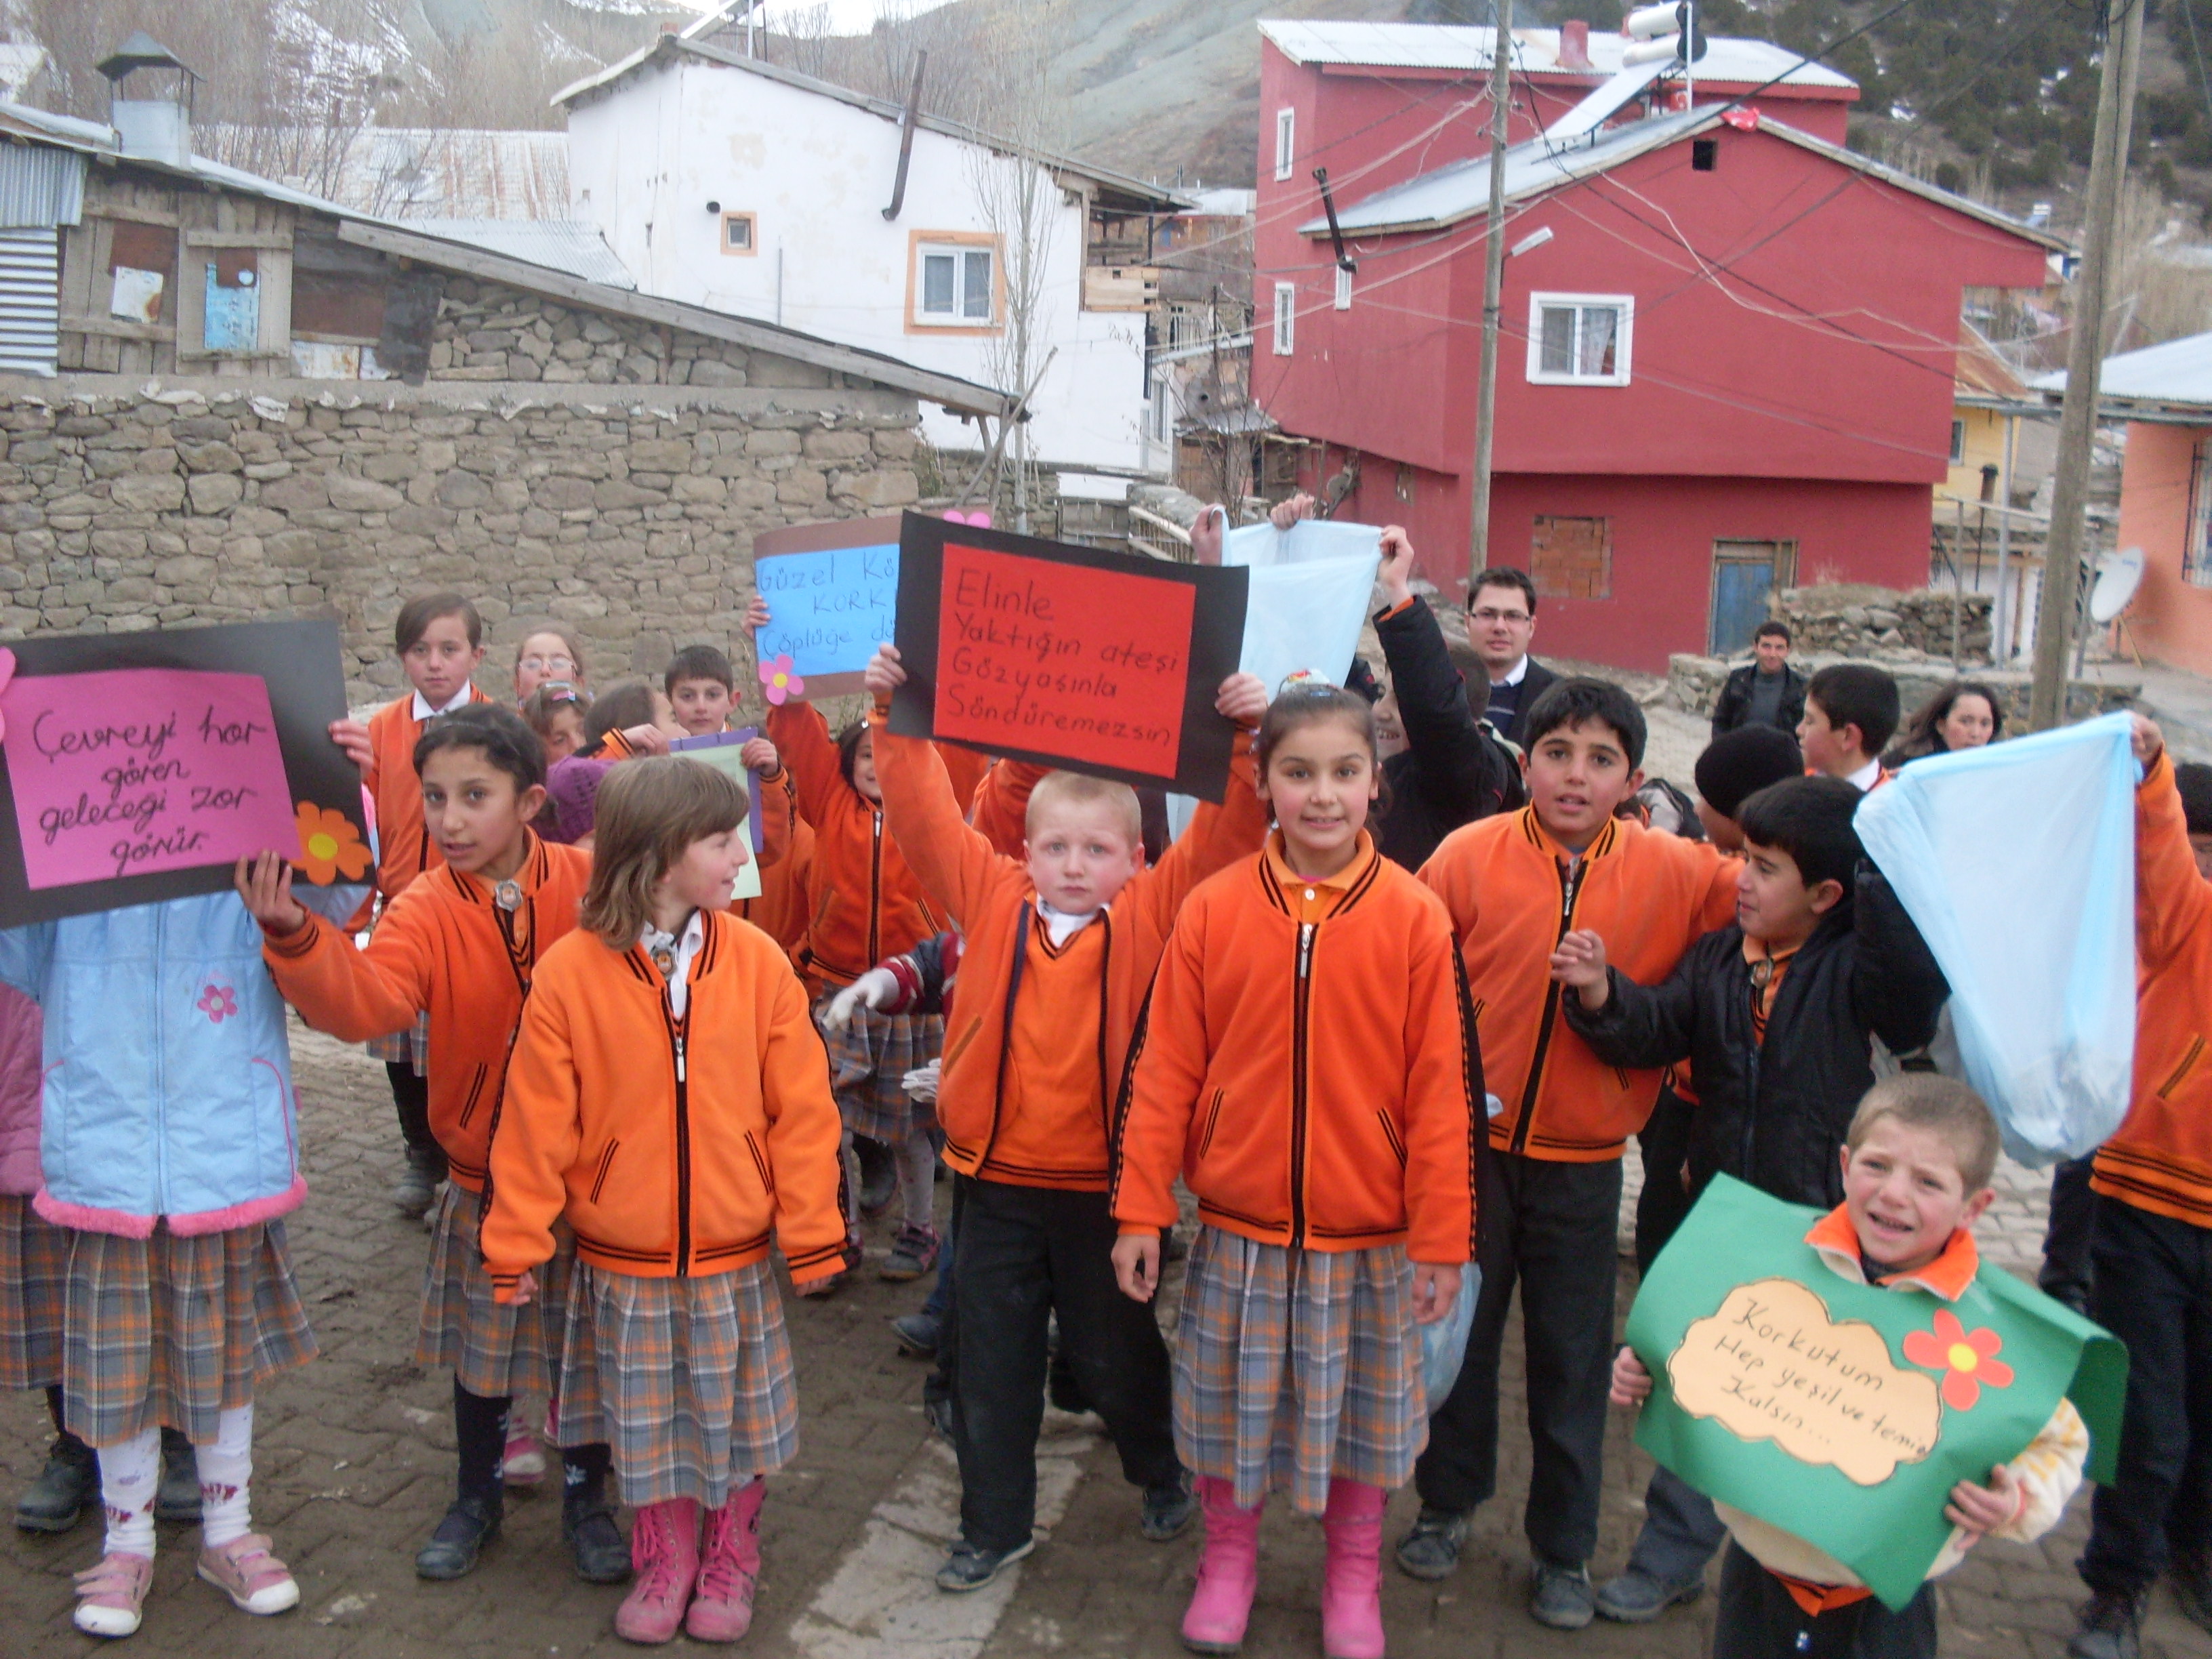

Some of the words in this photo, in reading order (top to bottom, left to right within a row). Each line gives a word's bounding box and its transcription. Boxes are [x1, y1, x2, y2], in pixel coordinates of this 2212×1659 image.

[759, 553, 834, 592] Güzel
[863, 550, 895, 581] Kö
[956, 567, 1054, 621] Elinle
[813, 588, 897, 615] KORK
[954, 611, 1081, 663] Yaktığın
[1099, 642, 1179, 675] ateşi
[33, 708, 177, 764] Çevreyi
[198, 704, 267, 745] hor
[190, 786, 259, 812] zor
[1732, 1297, 1883, 1391] Korkutum
[1714, 1335, 1765, 1372] Hep
[1772, 1367, 1843, 1406] yeşil
[1841, 1404, 1864, 1420] ve
